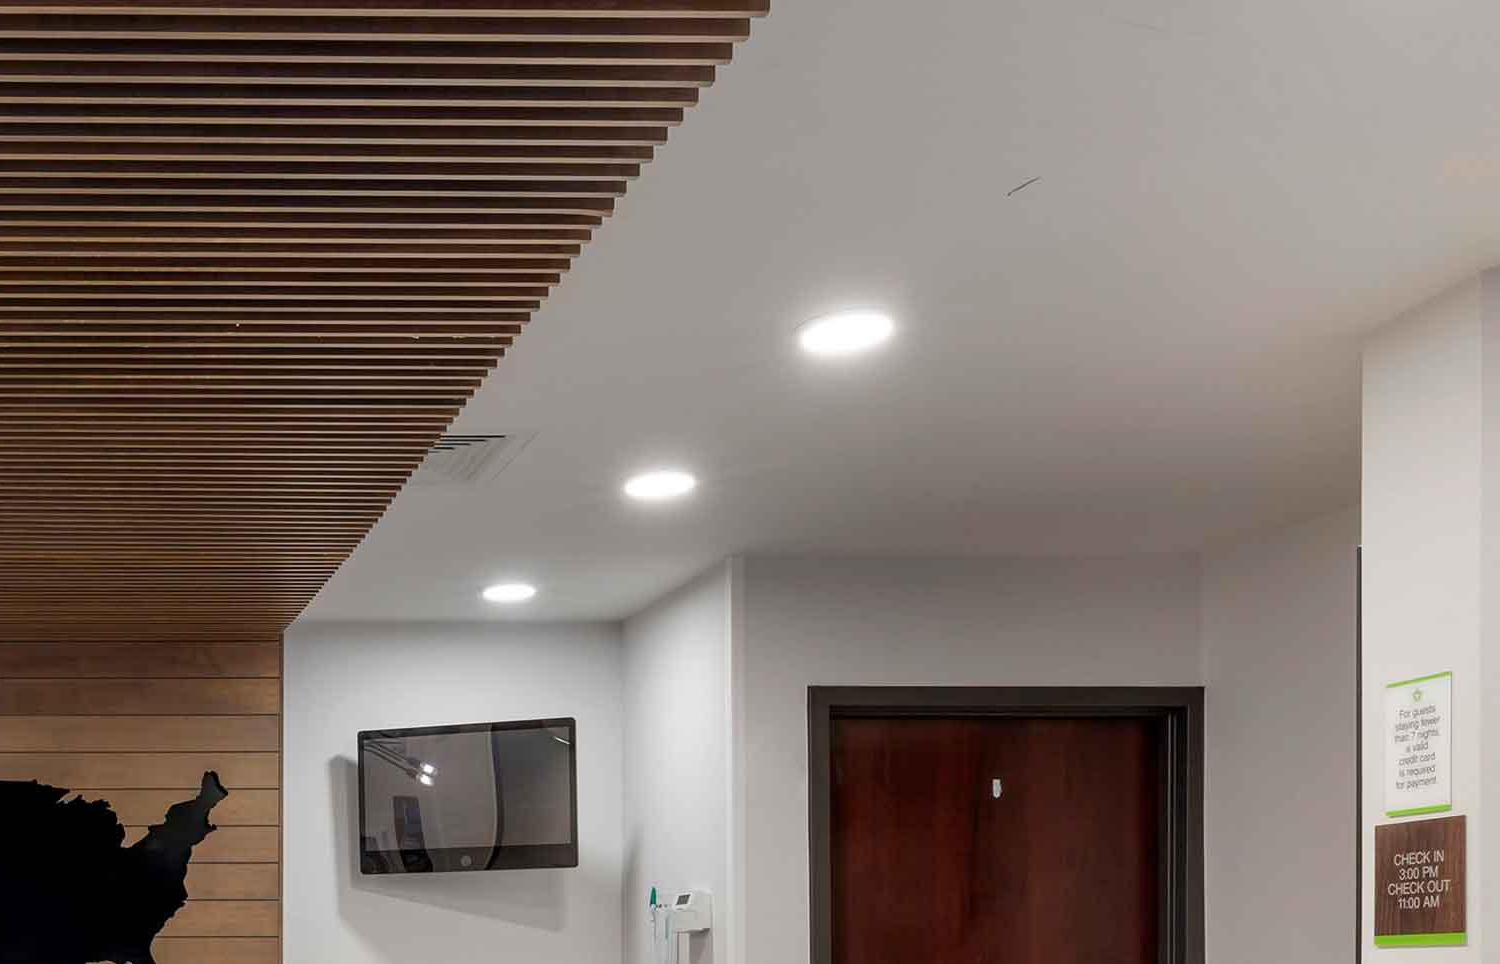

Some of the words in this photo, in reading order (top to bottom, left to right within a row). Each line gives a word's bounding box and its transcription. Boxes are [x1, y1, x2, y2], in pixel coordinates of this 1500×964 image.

[1398, 709, 1411, 719] For
[1412, 705, 1437, 719] guests
[1395, 720, 1420, 732] staying
[1420, 716, 1441, 726] fewer
[1394, 734, 1410, 744] than
[1412, 741, 1429, 752] valid
[1398, 755, 1419, 766] credit
[1419, 752, 1436, 762] card
[1406, 764, 1436, 776] required
[1393, 851, 1431, 866] CHECK
[1433, 849, 1445, 863] IN
[1398, 867, 1420, 881] 3:00
[1422, 865, 1439, 878] PM
[1387, 881, 1425, 896] CHECK
[1427, 879, 1452, 894] OUT
[1397, 896, 1421, 910] 11:00
[1422, 895, 1440, 908] AM
